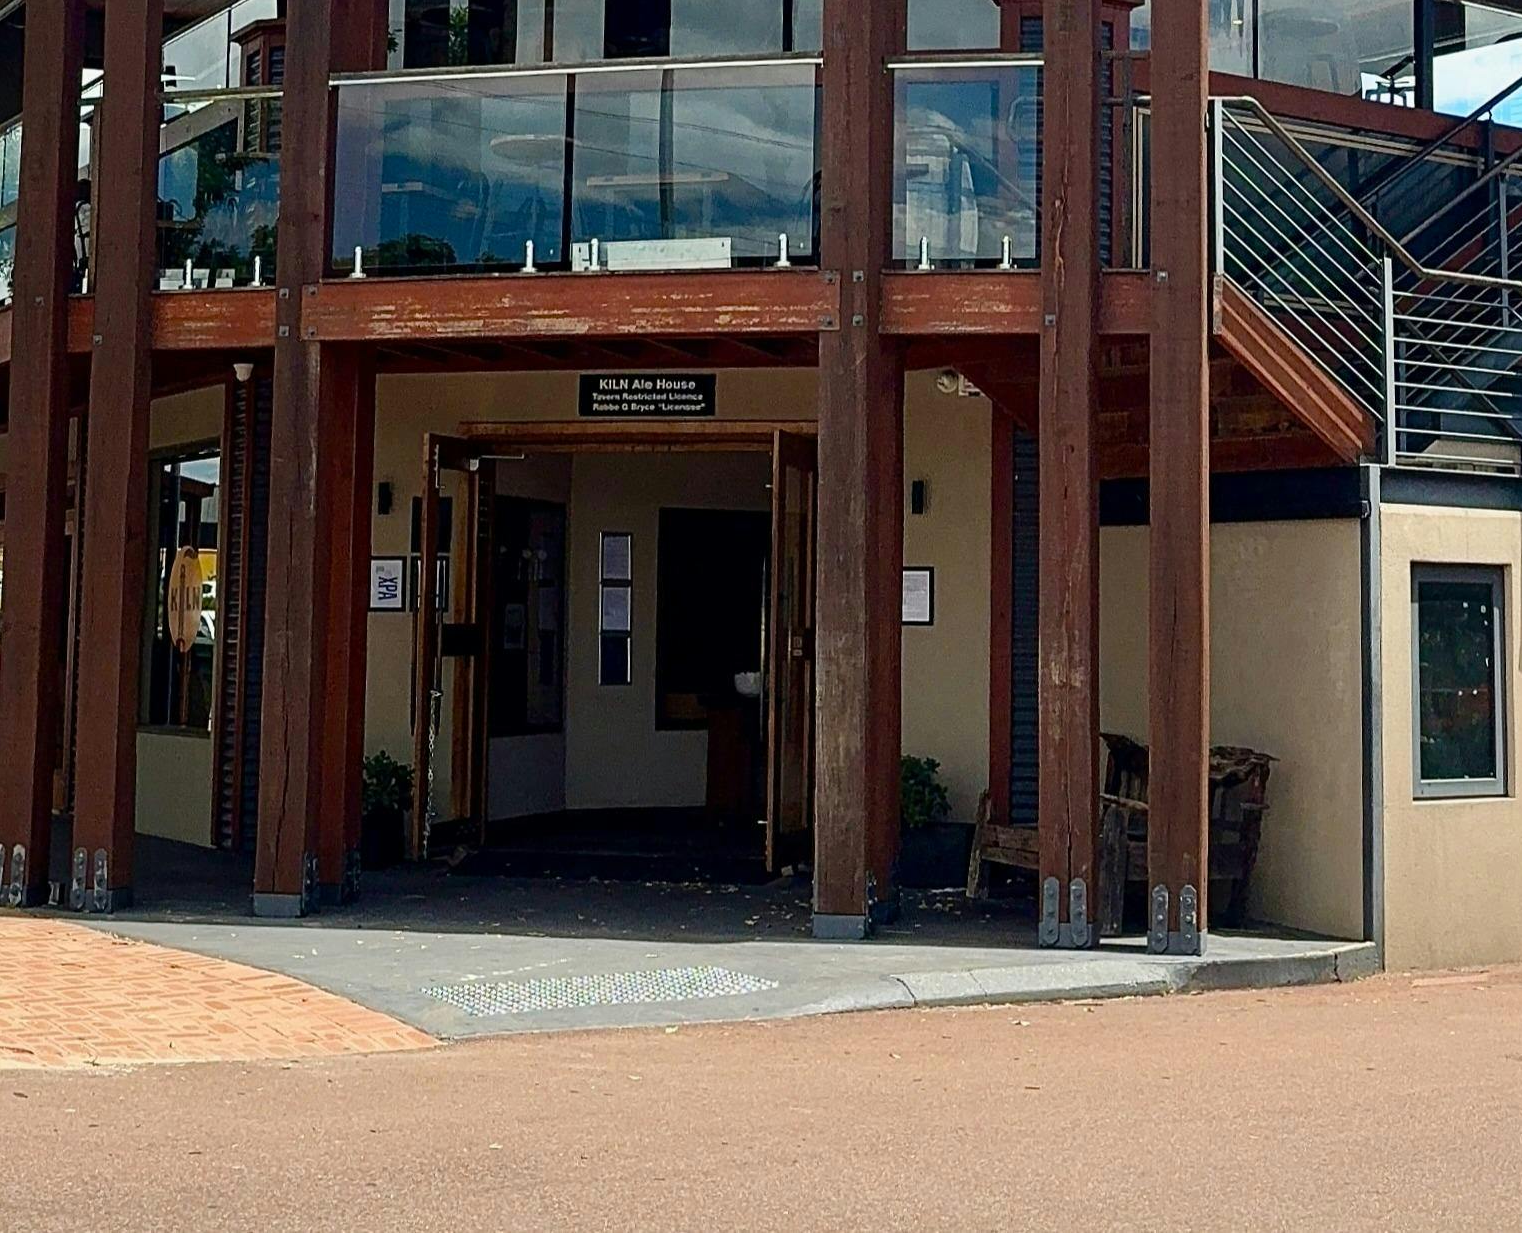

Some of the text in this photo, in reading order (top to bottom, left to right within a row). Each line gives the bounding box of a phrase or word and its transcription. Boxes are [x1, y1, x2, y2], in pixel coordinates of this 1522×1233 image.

[599, 379, 696, 390] KILN Ale House
[622, 392, 667, 401] Restricted
[630, 403, 655, 413] Bryce
[377, 575, 399, 601] XPA
